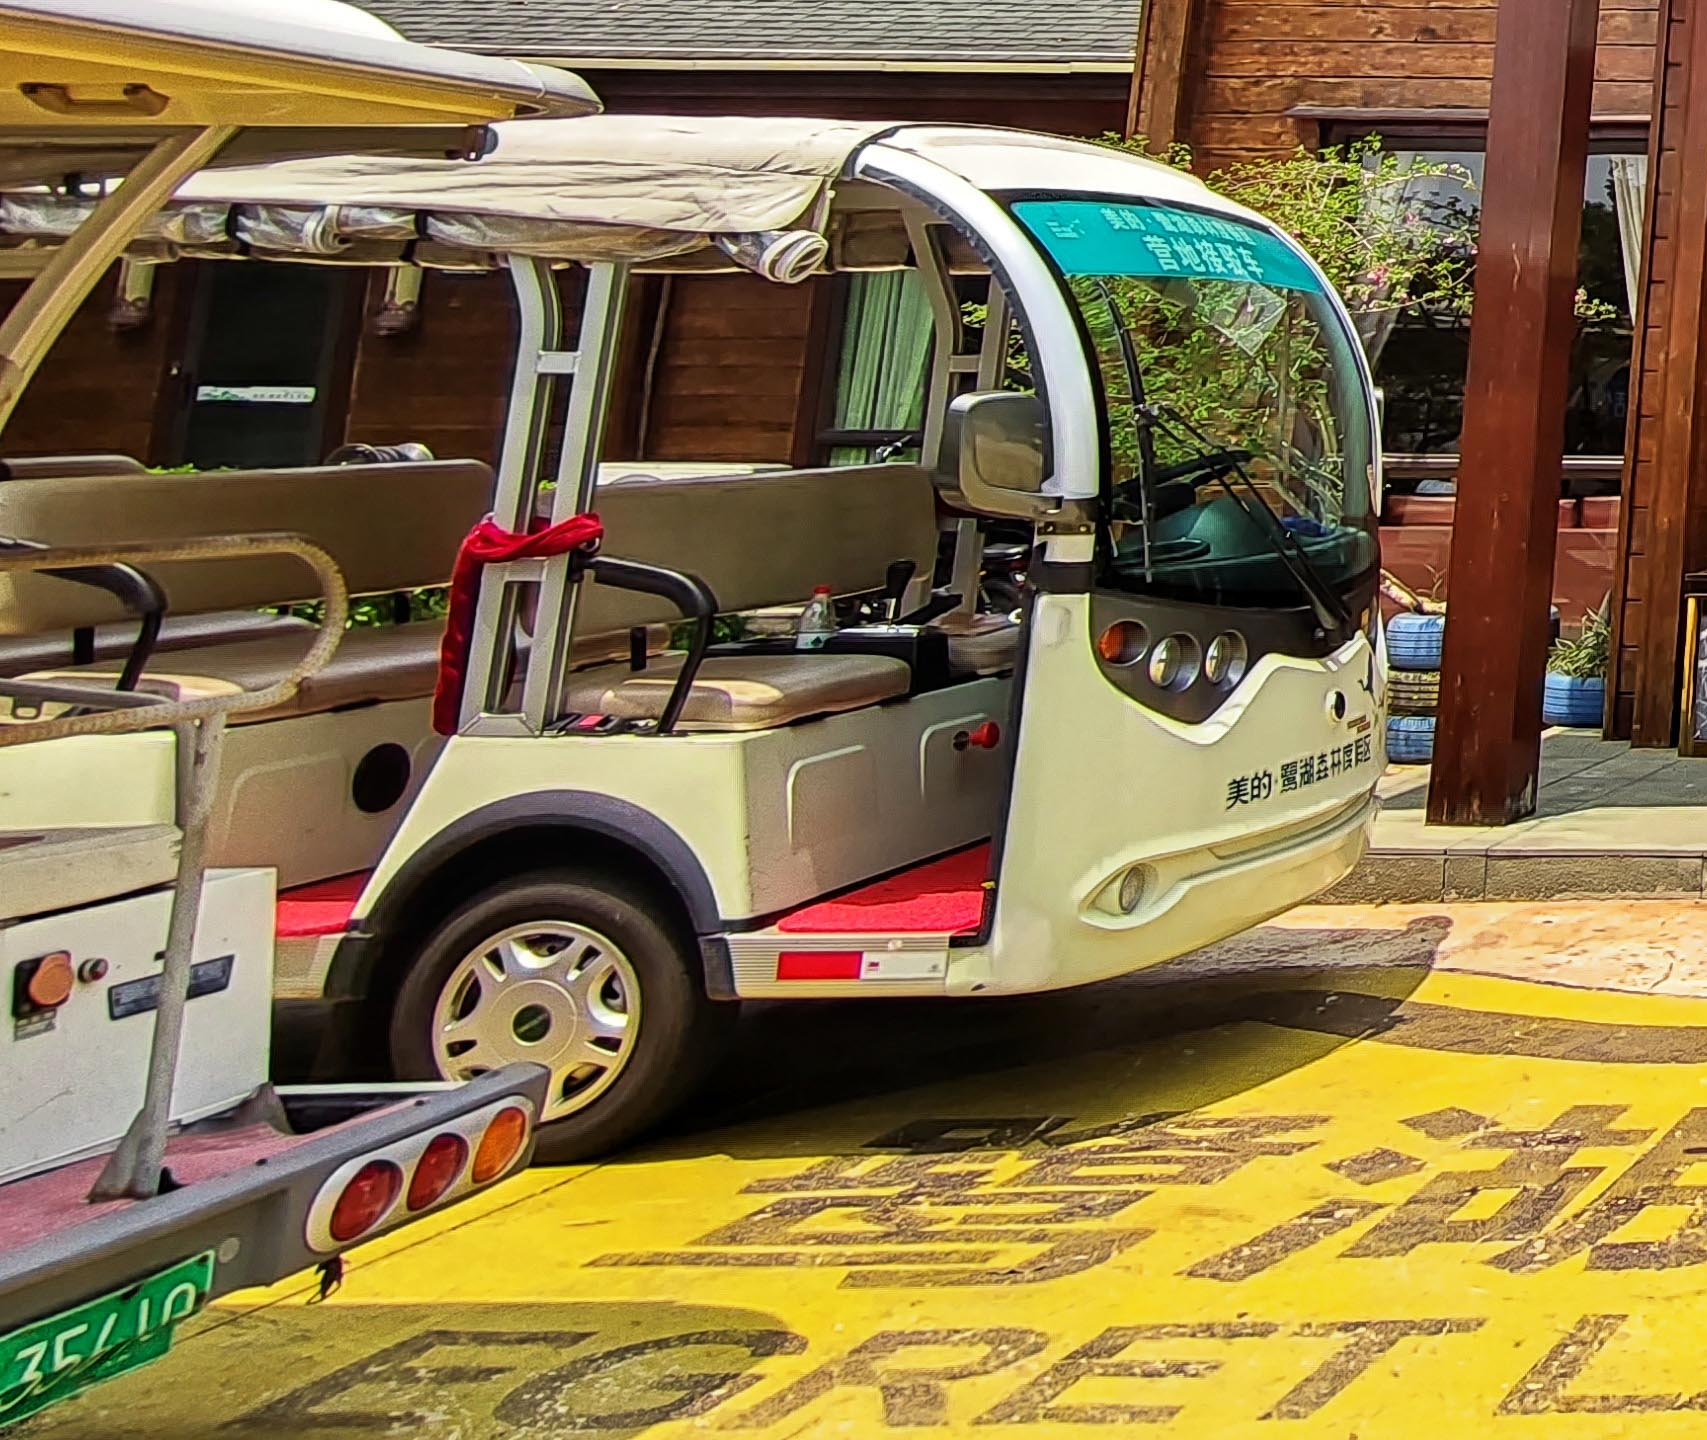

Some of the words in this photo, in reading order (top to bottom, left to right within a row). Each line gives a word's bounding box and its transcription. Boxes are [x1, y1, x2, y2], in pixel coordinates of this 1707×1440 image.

[1142, 234, 1265, 280] 营地接驳车
